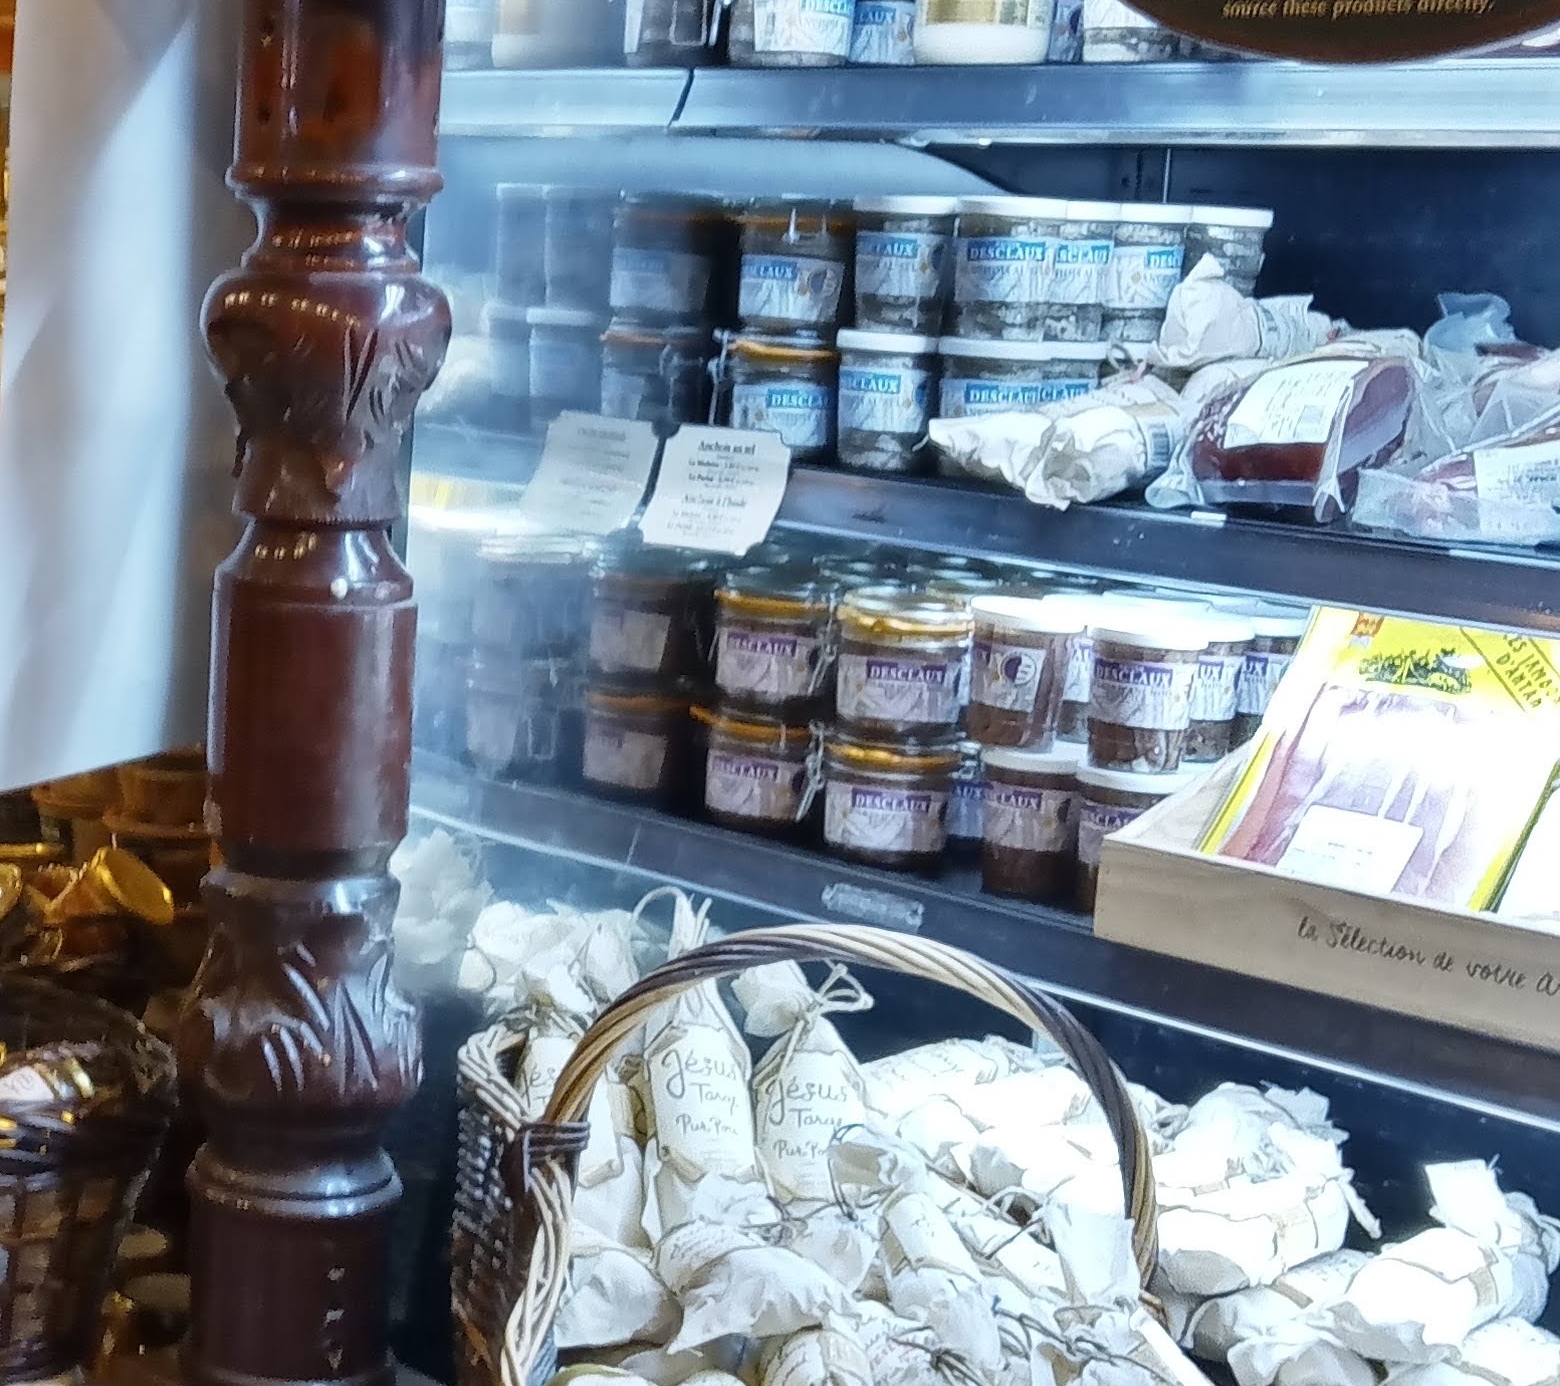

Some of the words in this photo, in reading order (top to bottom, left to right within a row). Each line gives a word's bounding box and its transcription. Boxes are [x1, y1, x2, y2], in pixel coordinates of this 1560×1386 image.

[870, 664, 943, 683] DESCLAUX
[1095, 666, 1171, 687] DESCLAUX
[856, 795, 928, 812] DESCLAUX
[1433, 951, 1455, 973] de
[1466, 961, 1527, 990] votre
